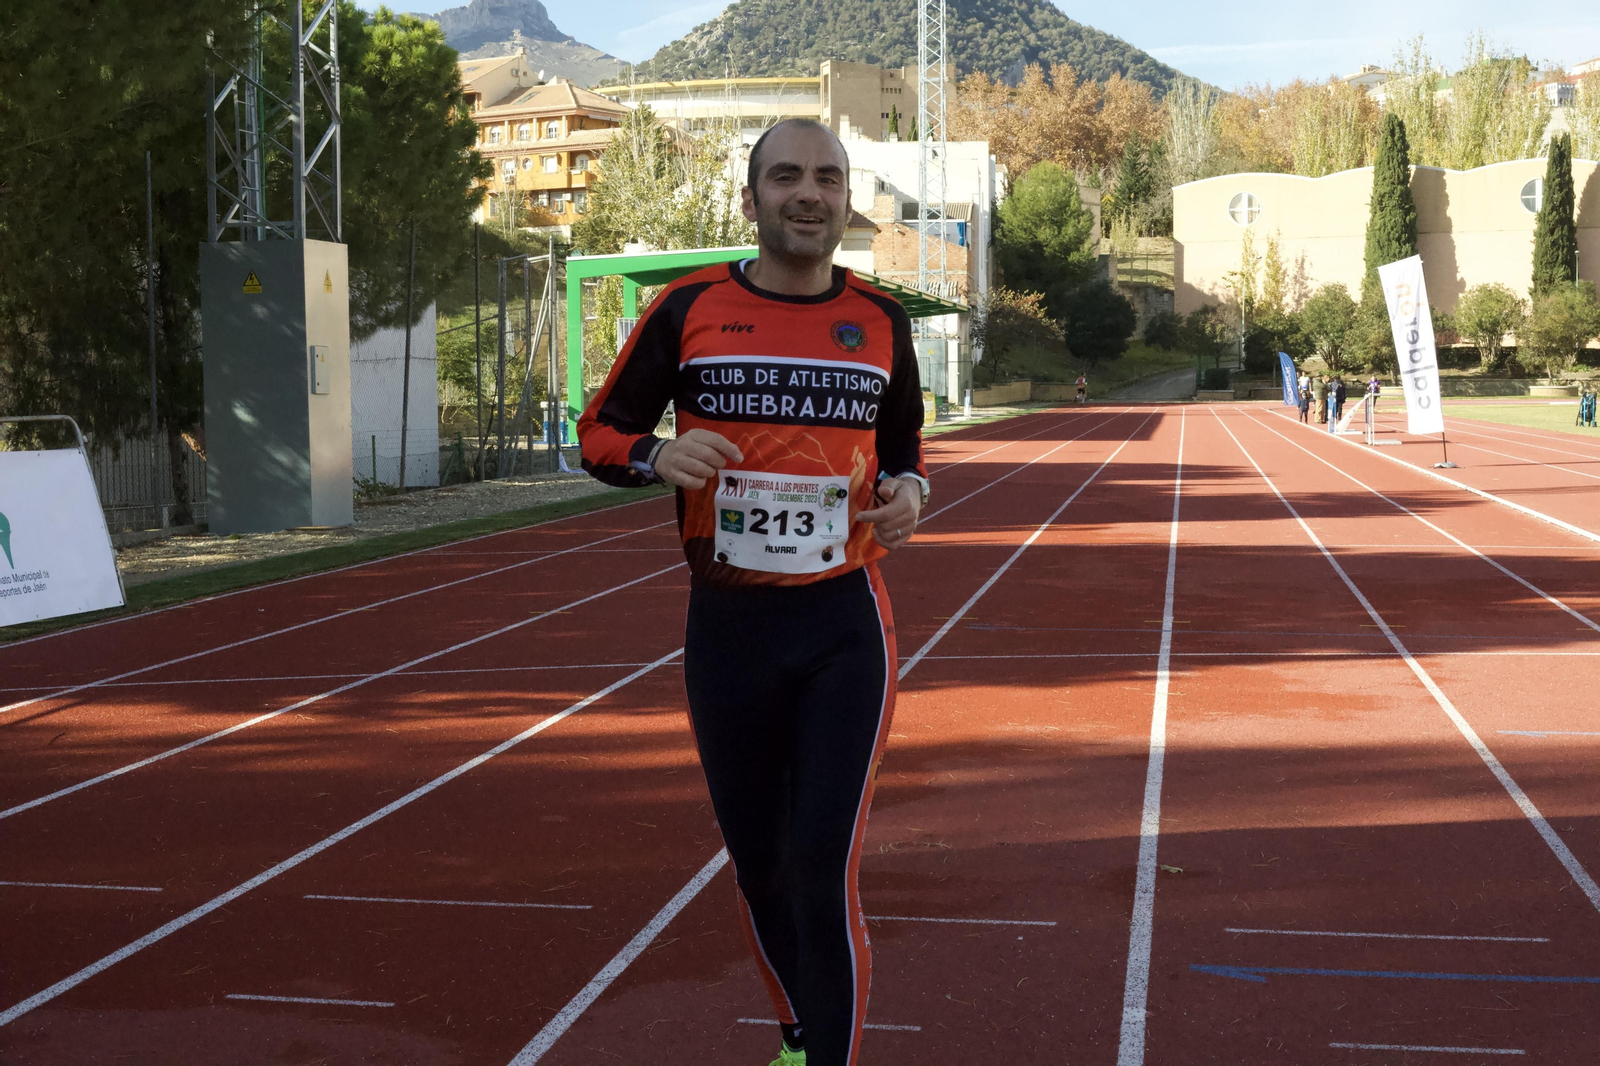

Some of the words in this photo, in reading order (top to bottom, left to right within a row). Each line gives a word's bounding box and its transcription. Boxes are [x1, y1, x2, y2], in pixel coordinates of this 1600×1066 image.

[700, 369, 746, 385] CLUB
[755, 369, 779, 385] DE
[788, 370, 882, 395] ATLETISMO
[698, 393, 878, 423] QUIEBRAJANO
[748, 479, 774, 492] CARRERA
[775, 481, 779, 491] A
[781, 482, 792, 493] LOS
[792, 483, 819, 494] PUENTES
[772, 493, 777, 502] 3
[777, 493, 804, 503] DICIEMBRE
[804, 494, 818, 503] 2023
[748, 508, 815, 537] 213
[12, 570, 42, 582] Municipal
[22, 585, 32, 594] de
